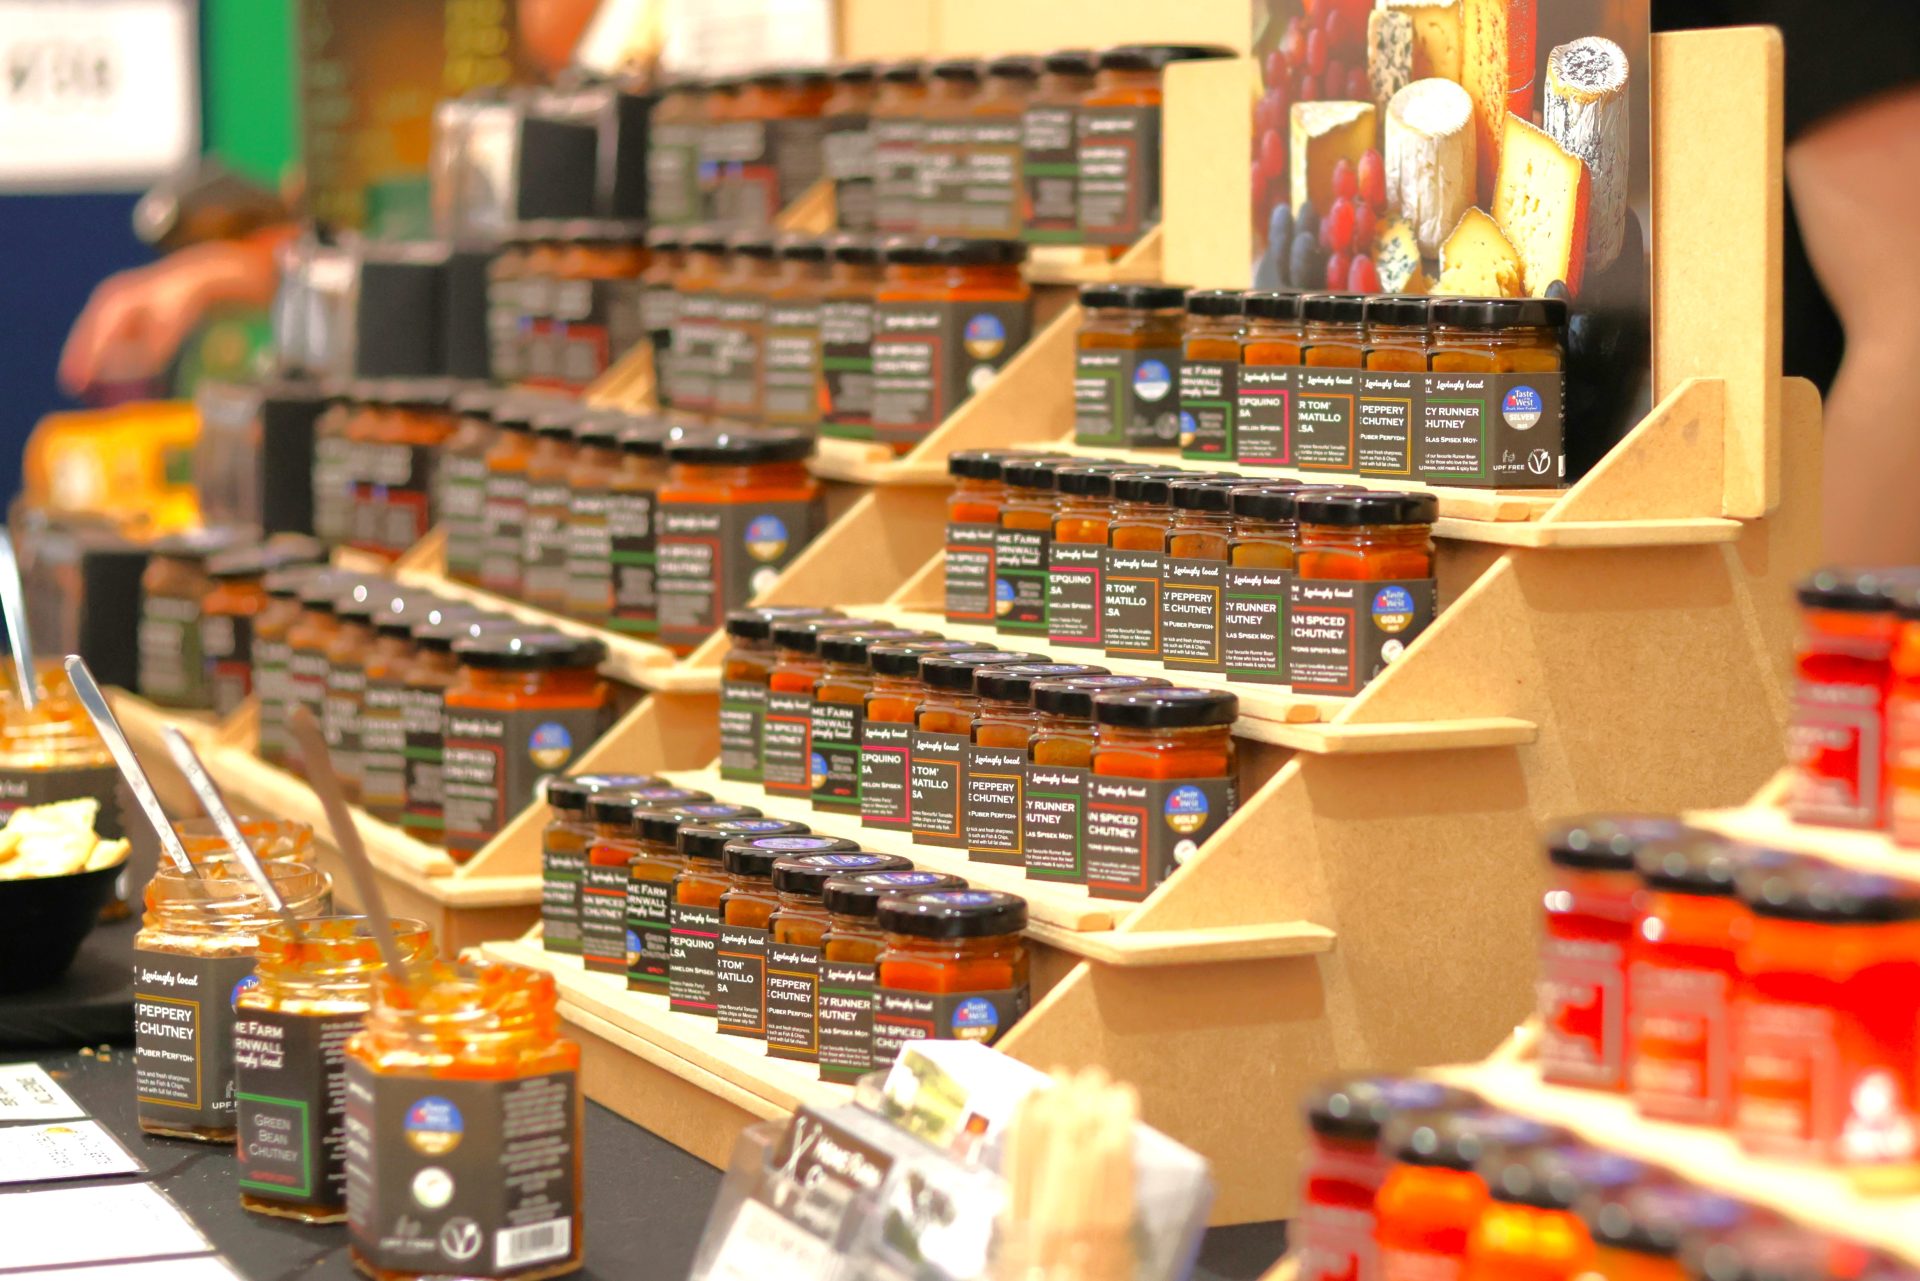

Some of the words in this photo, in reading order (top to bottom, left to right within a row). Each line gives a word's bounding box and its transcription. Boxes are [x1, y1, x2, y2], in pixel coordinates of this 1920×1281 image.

[1365, 378, 1393, 390] Lovingly
[1394, 380, 1411, 388] local
[1436, 379, 1465, 391] Lovingly
[1467, 380, 1484, 389] local
[1515, 389, 1534, 398] Taste
[1515, 398, 1533, 407] West
[1361, 405, 1405, 415] PEPPERY
[1439, 407, 1480, 417] RUNNER
[1362, 417, 1405, 426] CHUTNEY
[1013, 533, 1041, 545] FARM
[1141, 559, 1158, 569] local
[1202, 566, 1219, 576] local
[1264, 576, 1281, 587] local
[1171, 592, 1213, 602] PEPPERY
[1171, 604, 1213, 614] CHUTNEY
[1236, 602, 1277, 613] RUNNER
[1306, 615, 1346, 627] SPICED
[1380, 614, 1405, 624] GOLD
[1294, 627, 1344, 639] CHUTNEY
[827, 707, 854, 719] FARM
[891, 729, 908, 739] local
[943, 741, 960, 752] local
[1003, 755, 1020, 766] local
[973, 780, 1015, 792] PEPPERY
[1061, 774, 1079, 786] local
[973, 793, 1015, 805] CHUTNEY
[1034, 801, 1075, 814] RUNNER
[1099, 811, 1139, 826] SPICED
[1088, 824, 1137, 840] CHUTNEY
[641, 883, 668, 898] FARM
[721, 933, 747, 948] Lovingly
[747, 937, 764, 949] local
[772, 951, 800, 966] Lovingly
[800, 954, 817, 965] local
[141, 967, 176, 988] Lovingly
[176, 971, 199, 987] local
[770, 977, 812, 992] PEPPERY
[770, 989, 812, 1004] CHUTNEY
[830, 996, 871, 1010] RUNNER
[139, 1003, 193, 1023] PEPPERY
[140, 1022, 195, 1041] CHUTNEY
[249, 1022, 285, 1040] FARM
[887, 1025, 926, 1040] SPICED
[138, 1046, 162, 1059] PUBER
[211, 1101, 233, 1111] UPF
[254, 1112, 292, 1131] GREEN
[258, 1128, 289, 1146] BEAN
[249, 1143, 298, 1162] CHUTNEY
